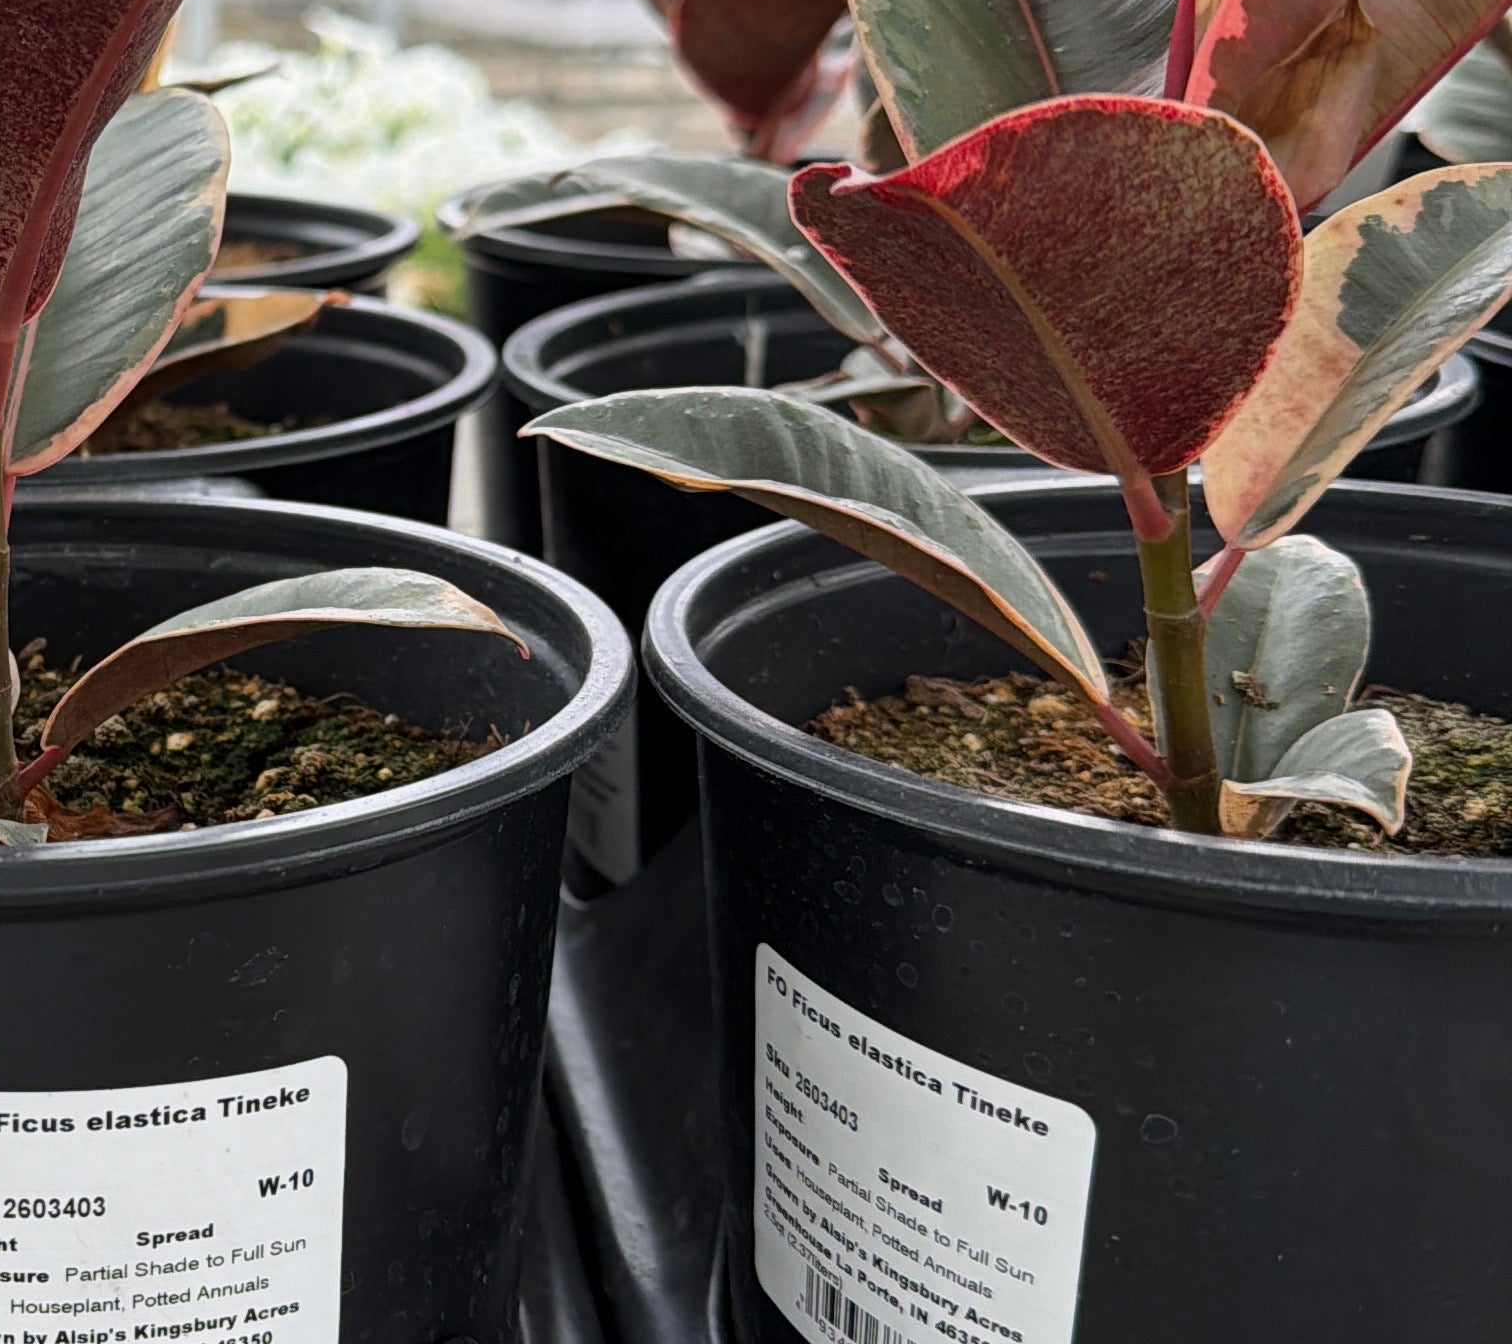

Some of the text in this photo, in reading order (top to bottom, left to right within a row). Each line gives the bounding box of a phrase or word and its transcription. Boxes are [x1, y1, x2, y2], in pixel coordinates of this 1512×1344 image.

[767, 965, 1049, 1137] FO Ficus elastica Tineke
[86, 1105, 207, 1131] elastica
[216, 1086, 311, 1118] Tineke
[765, 1076, 804, 1123] Height
[766, 1042, 859, 1132] Sku 2603403
[258, 1168, 314, 1198] W-10
[765, 1104, 1035, 1285] Exposure Partial Shade to Full Sun
[878, 1167, 943, 1214] Spread
[986, 1184, 1048, 1226] W-10
[3, 1196, 106, 1219] 2603403
[764, 1131, 994, 1299] Uses Houseplant, Potted Annuals
[136, 1222, 214, 1249] Spread
[765, 1162, 1023, 1344] Grown by Alsip's Kingsbury Acres
[765, 1185, 832, 1260] Greenhouse
[836, 1253, 853, 1277] La
[857, 1270, 904, 1314] Porte,
[910, 1302, 929, 1325] IN
[65, 1264, 128, 1282] Partial
[135, 1257, 199, 1277] Shade
[206, 1254, 225, 1268] to
[231, 1244, 265, 1264] Full
[270, 1238, 307, 1256] Sun
[10, 1296, 126, 1317] Houseplant,
[132, 1288, 191, 1309] Potted
[196, 1276, 270, 1301] Annuals
[134, 1314, 238, 1340] Kingsbury
[244, 1301, 300, 1324] Acres
